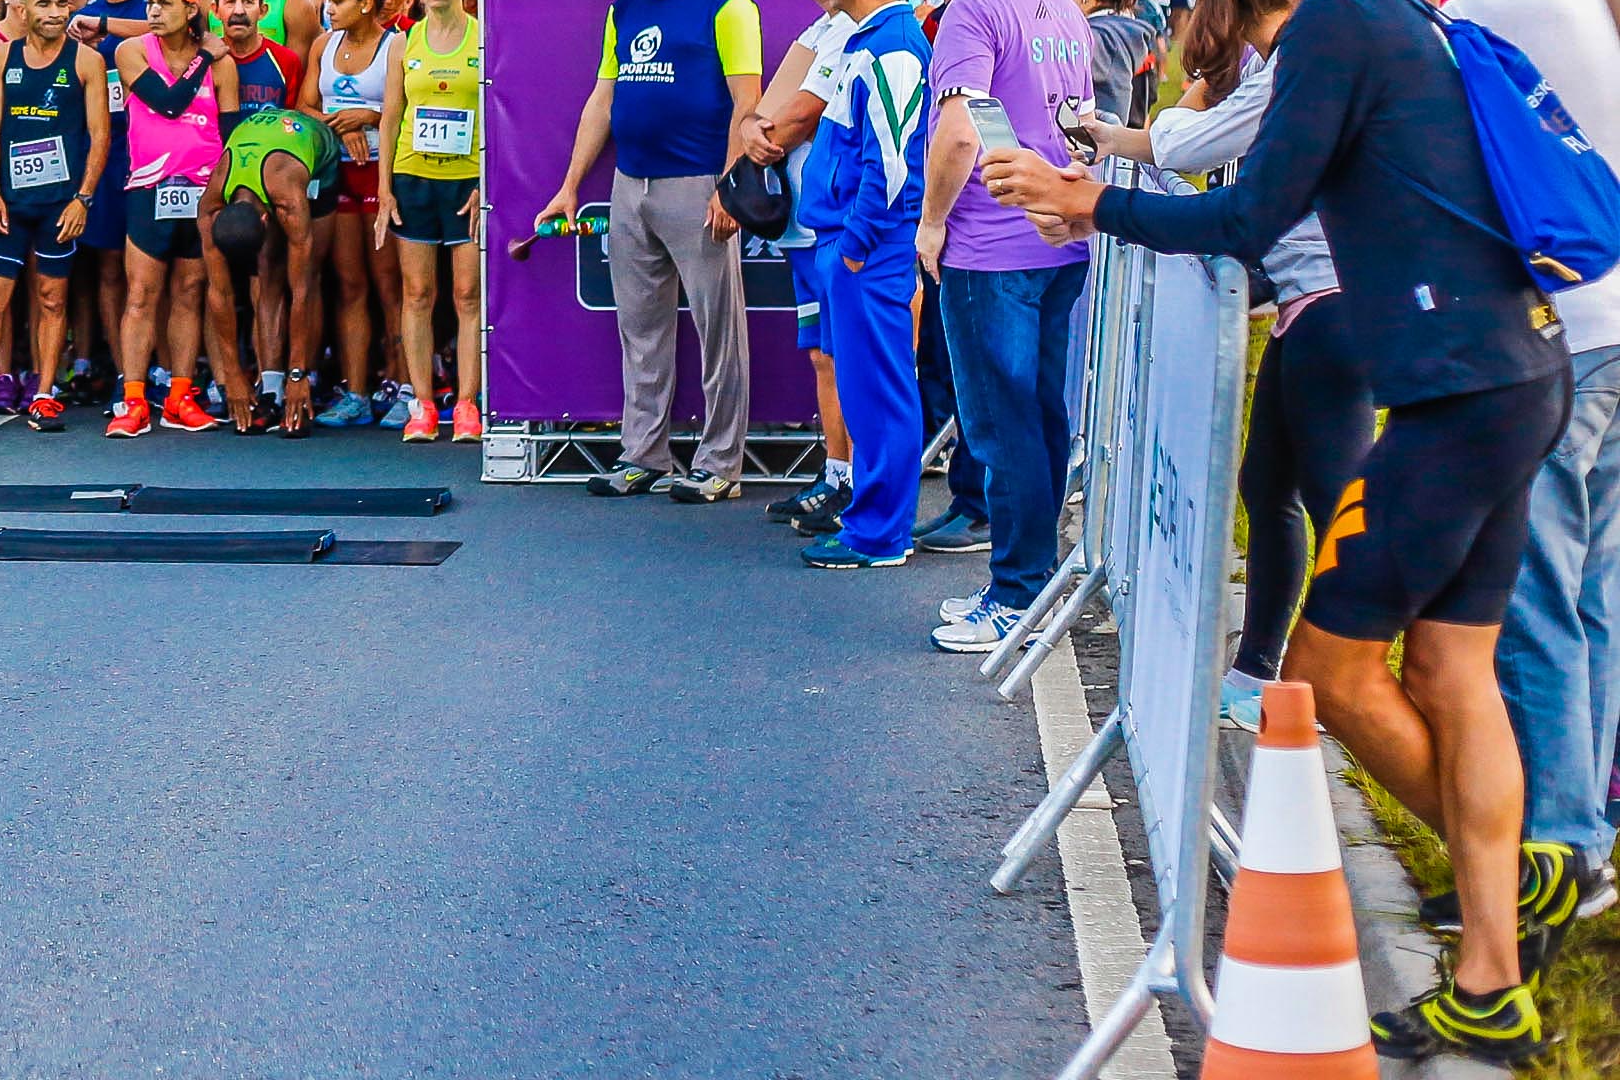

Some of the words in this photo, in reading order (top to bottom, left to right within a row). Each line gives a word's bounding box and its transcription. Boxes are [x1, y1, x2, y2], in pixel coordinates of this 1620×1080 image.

[618, 61, 675, 76] SPORTSUL
[418, 122, 449, 140] 211
[13, 156, 45, 176] 559
[159, 189, 190, 207] 560
